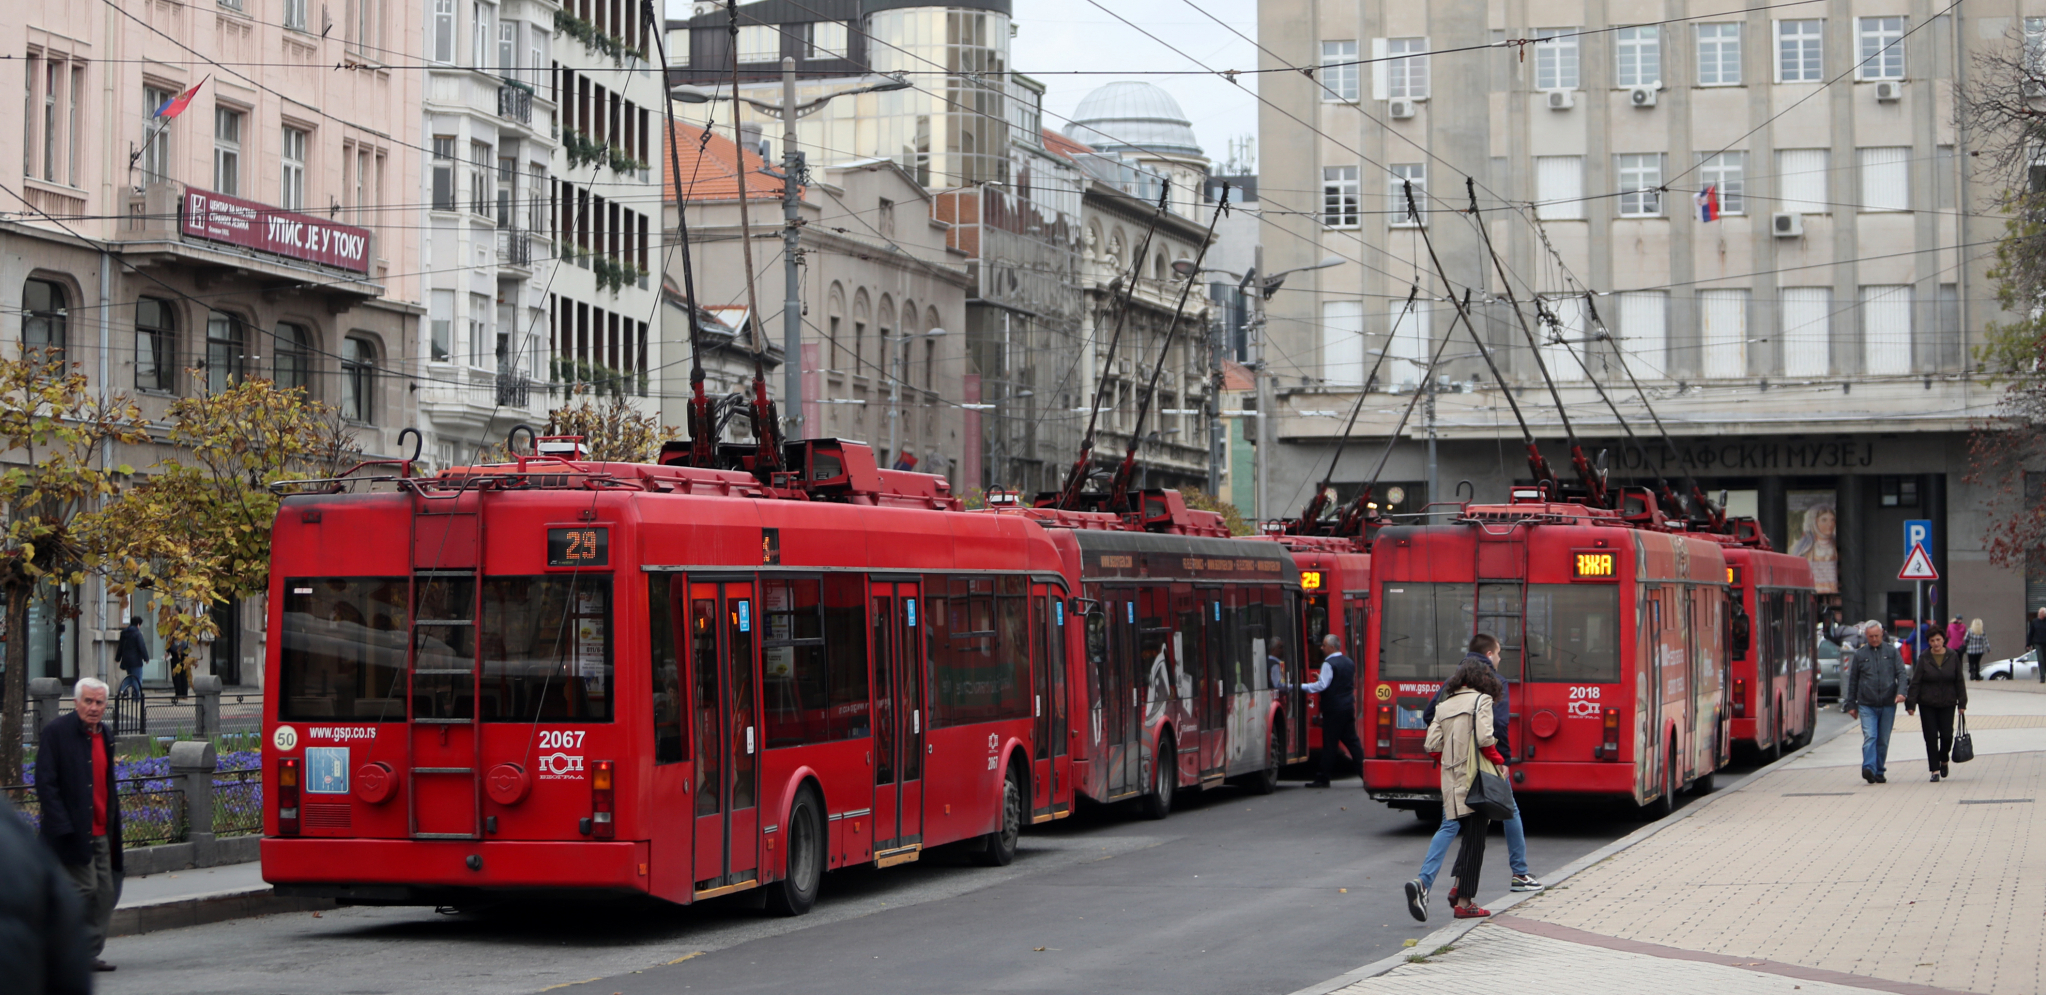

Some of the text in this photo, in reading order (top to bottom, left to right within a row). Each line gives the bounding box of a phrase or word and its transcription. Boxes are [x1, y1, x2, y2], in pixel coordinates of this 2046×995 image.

[268, 215, 365, 261] УПИС ЈЕ У ТОКУ
[1569, 443, 1873, 471] ТНОГРАФСКИ МУЗЕЈ
[566, 531, 596, 559] 29
[1911, 525, 1926, 547] P
[1301, 572, 1320, 588] 29
[1377, 688, 1391, 698] 50
[1569, 686, 1601, 699] 2018
[277, 732, 295, 746] 50
[309, 727, 377, 742] www.gsp.co.rs
[538, 730, 586, 748] 2067
[538, 752, 585, 774] ГСП
